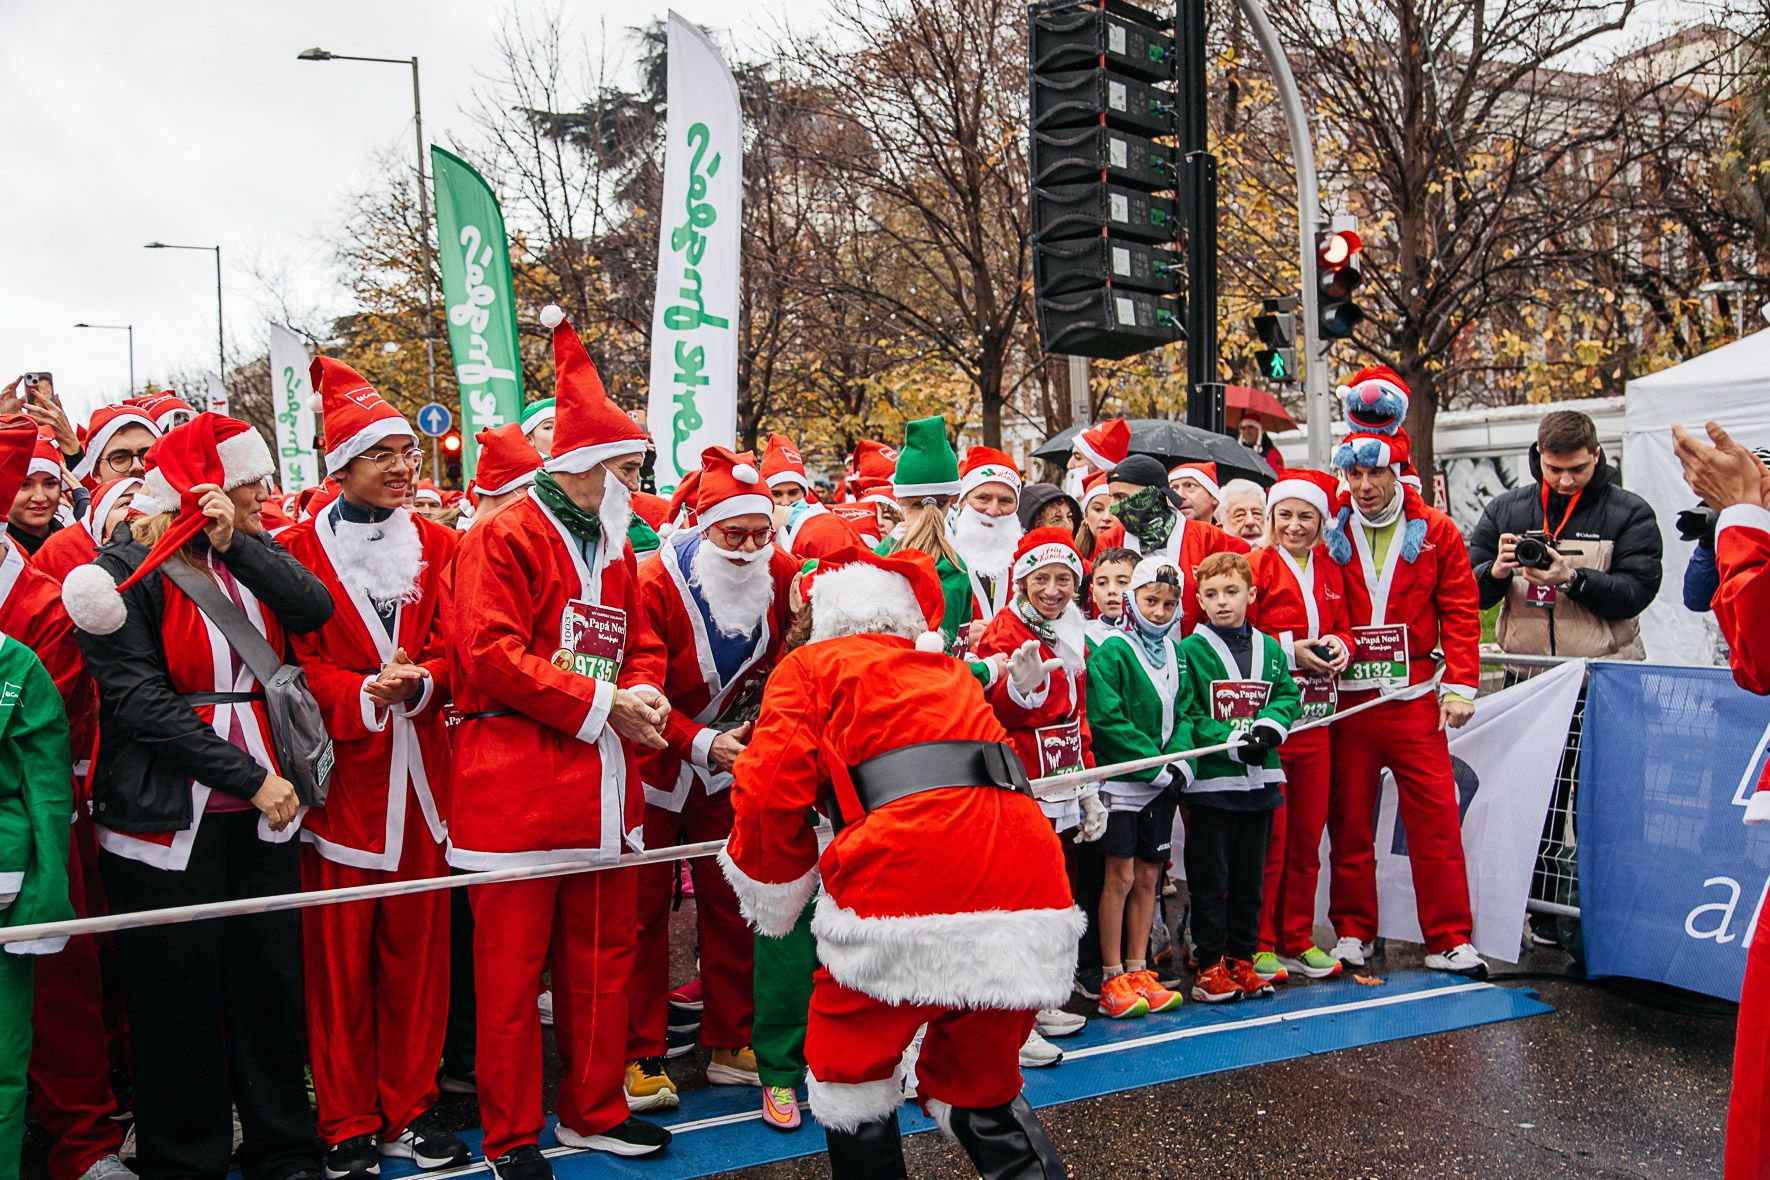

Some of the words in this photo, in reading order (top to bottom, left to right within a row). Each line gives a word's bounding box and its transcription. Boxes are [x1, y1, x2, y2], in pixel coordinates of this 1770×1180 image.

[589, 618, 610, 632] Papá
[1360, 635, 1380, 645] Papá
[1381, 634, 1400, 643] Noel
[575, 655, 613, 682] 9735
[1353, 661, 1393, 680] 3132
[1302, 703, 1328, 719] 3133
